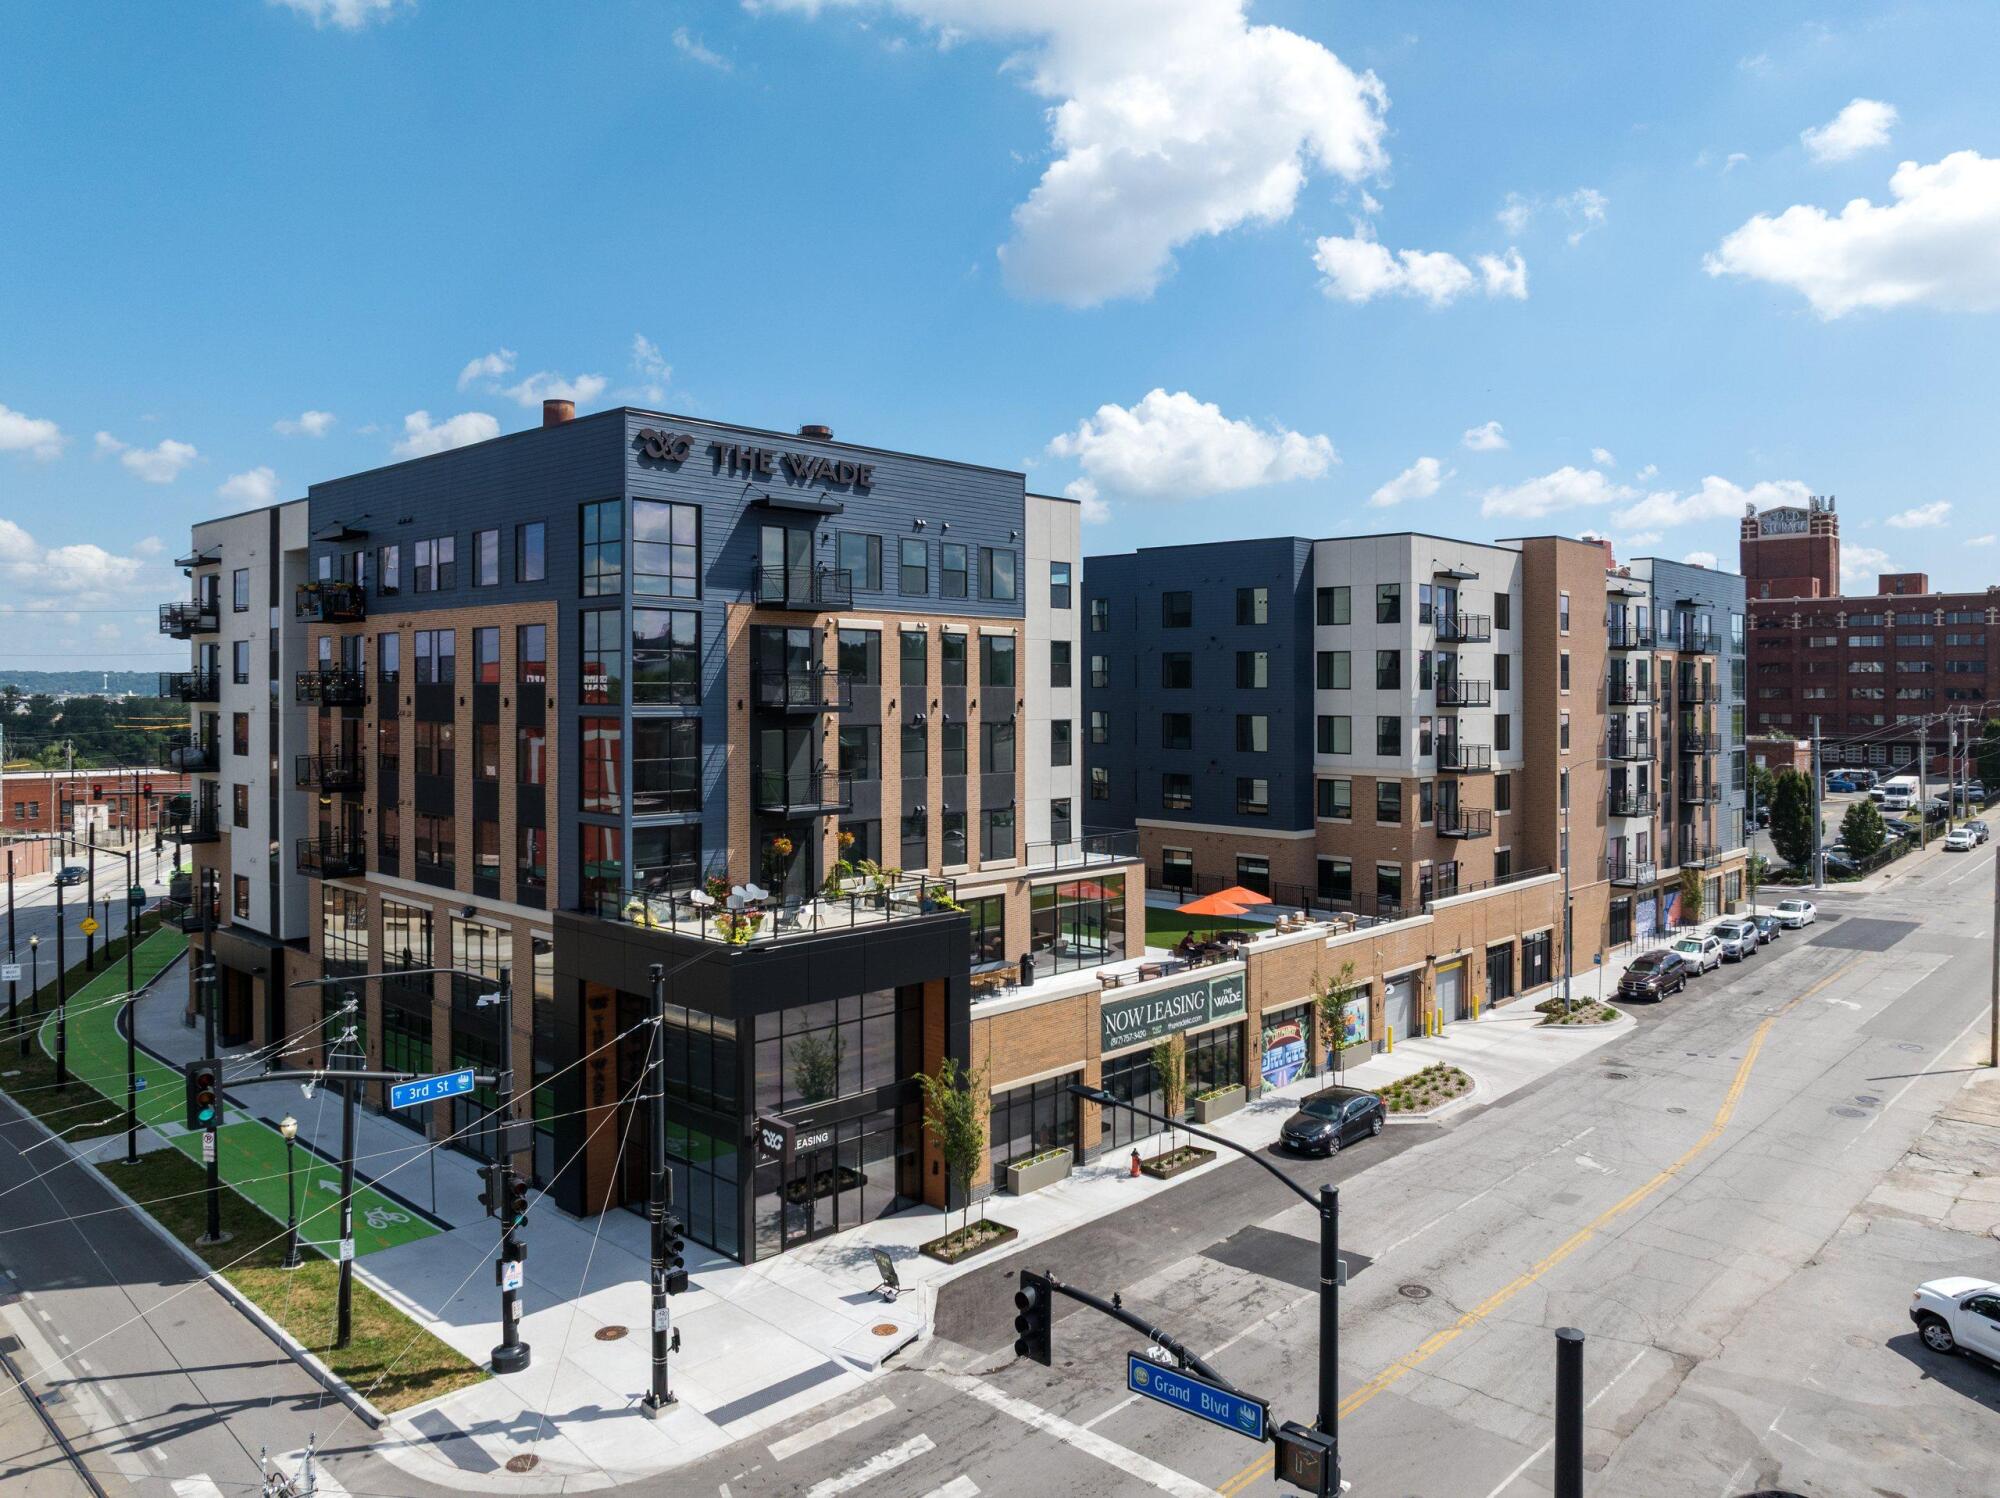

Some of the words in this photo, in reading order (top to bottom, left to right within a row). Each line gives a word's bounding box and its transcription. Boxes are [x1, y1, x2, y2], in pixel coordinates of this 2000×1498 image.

[712, 441, 777, 475] THE
[785, 452, 876, 487] WADE
[1214, 991, 1241, 1007] WADE
[1223, 987, 1233, 995] THE
[1106, 1007, 1144, 1034] NOW
[1147, 991, 1204, 1023] LEASING
[409, 1084, 429, 1100] 3rd
[436, 1080, 449, 1093] St
[795, 1133, 828, 1150] EASING
[1154, 1376, 1190, 1403] Grand
[1201, 1392, 1229, 1418] Blvd
